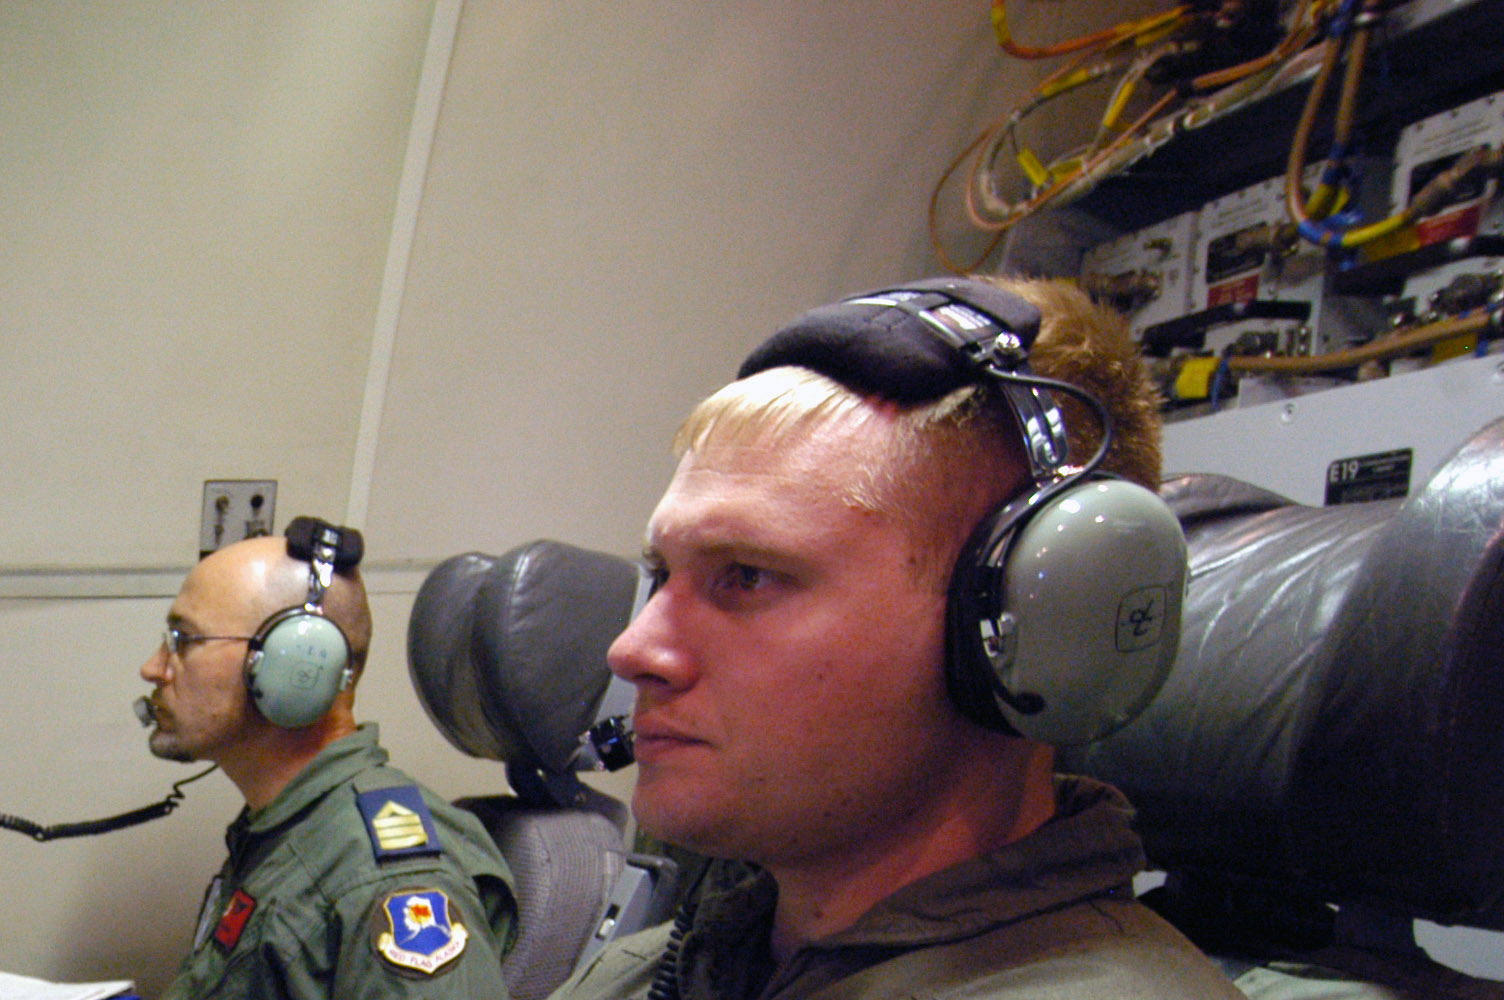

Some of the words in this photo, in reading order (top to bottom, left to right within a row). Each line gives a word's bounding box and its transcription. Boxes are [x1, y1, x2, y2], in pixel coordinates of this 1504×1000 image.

[1329, 459, 1359, 484] E19
[389, 948, 405, 962] RED
[410, 955, 433, 968] FLAG
